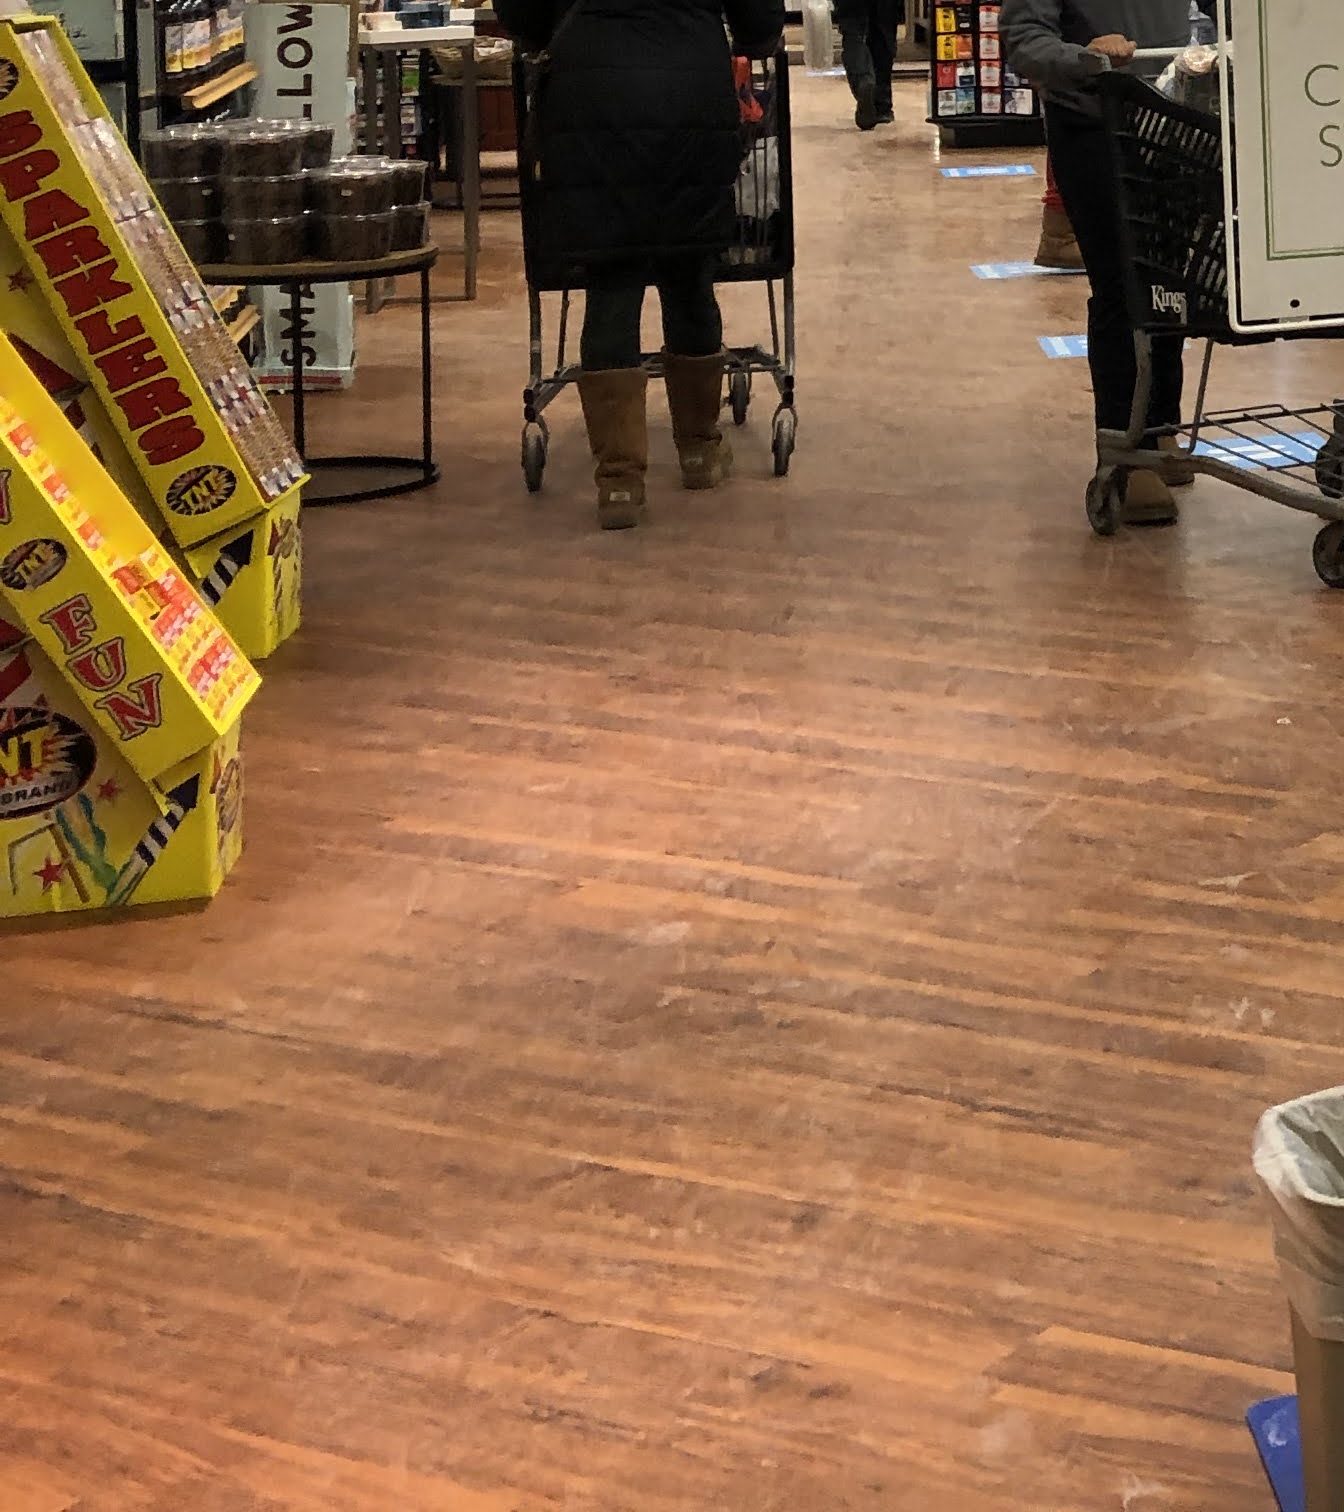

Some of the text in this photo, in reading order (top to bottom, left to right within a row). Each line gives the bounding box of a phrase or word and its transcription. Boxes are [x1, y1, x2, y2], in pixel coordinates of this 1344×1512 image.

[0, 109, 205, 465] SPARKLERS
[40, 593, 163, 741] FUN
[0, 724, 47, 778] NT
